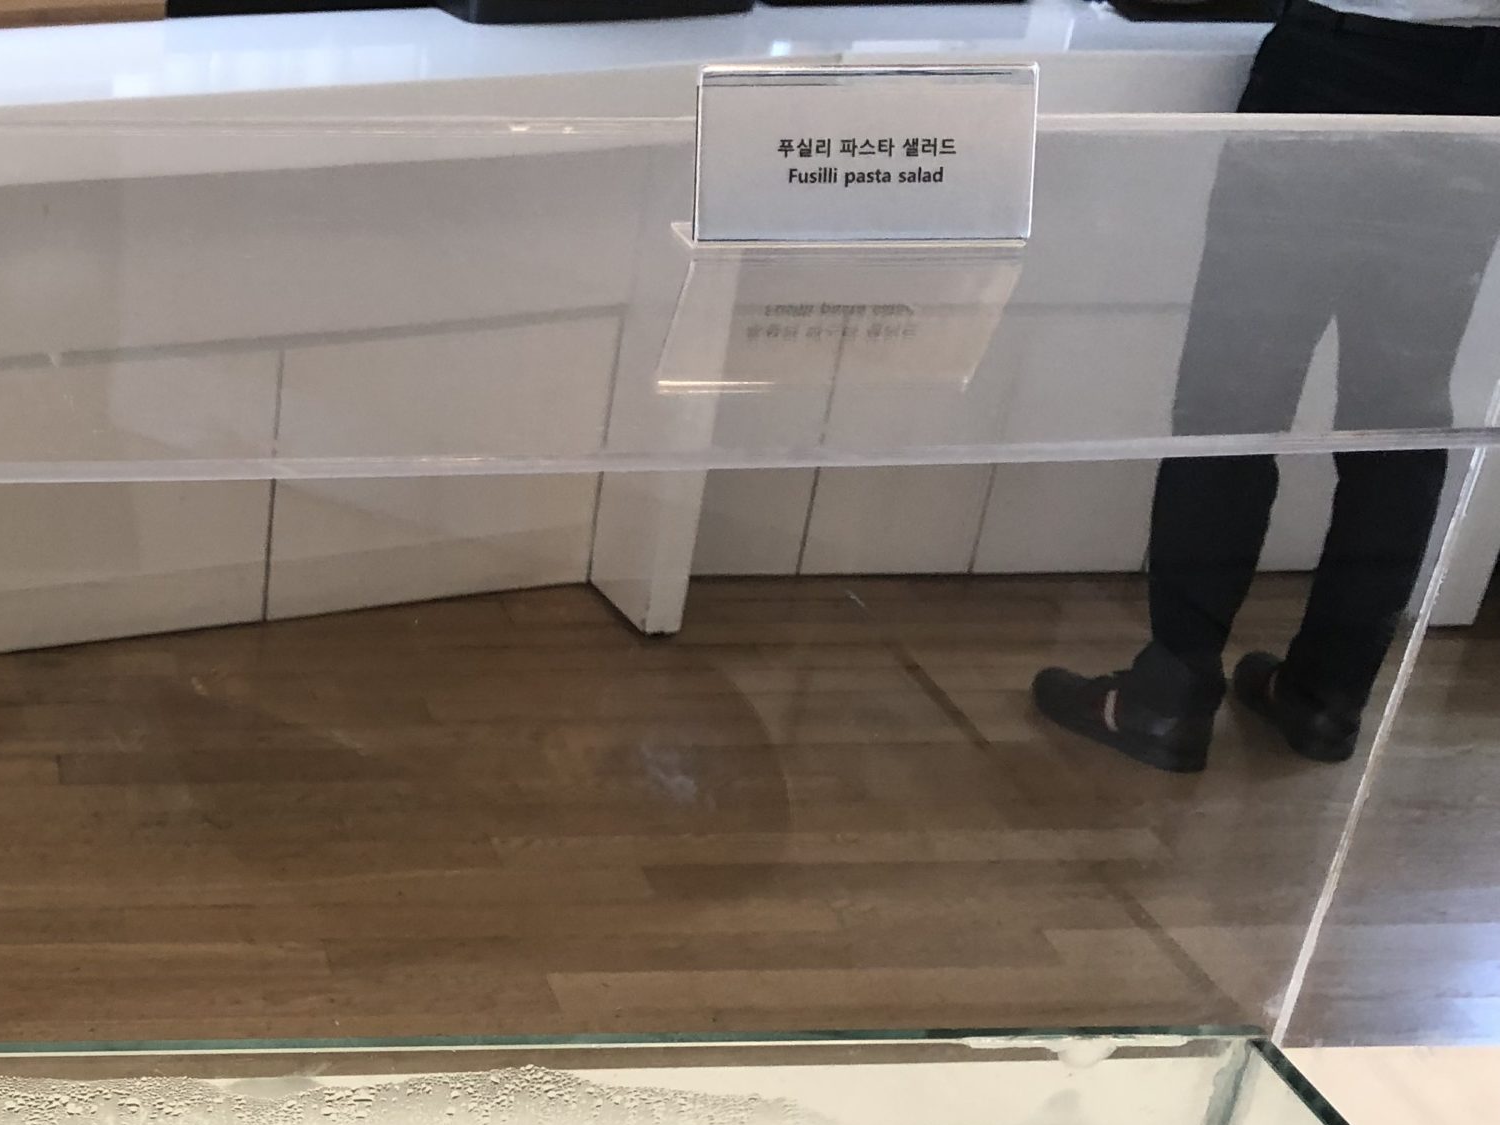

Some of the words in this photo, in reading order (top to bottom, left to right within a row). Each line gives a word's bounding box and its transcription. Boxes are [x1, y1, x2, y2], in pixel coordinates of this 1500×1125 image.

[777, 137, 832, 158] 푸실리
[839, 137, 895, 158] 파스타
[902, 137, 957, 158] 샐러드
[788, 166, 838, 184] Fusilli
[844, 168, 892, 188] pasta
[898, 166, 944, 184] salad
